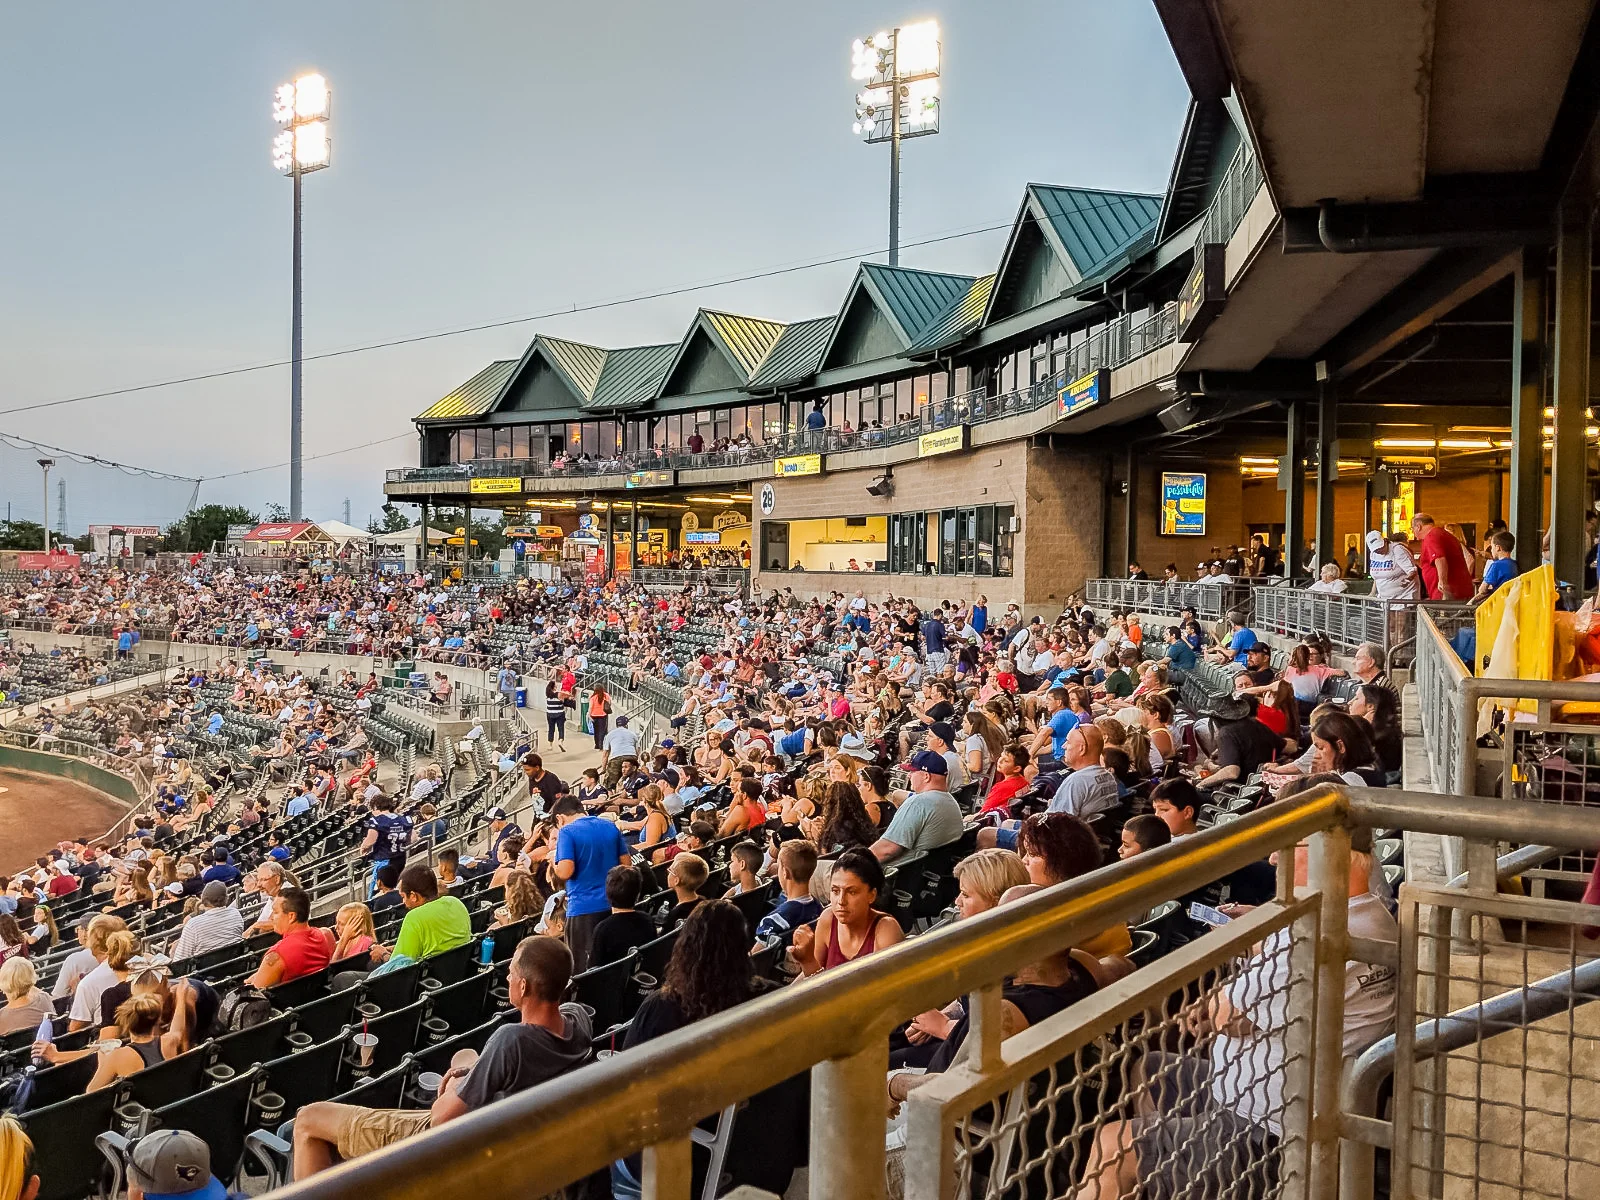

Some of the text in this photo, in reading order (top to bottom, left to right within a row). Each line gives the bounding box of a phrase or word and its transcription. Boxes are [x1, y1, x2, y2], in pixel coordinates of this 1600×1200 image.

[763, 490, 772, 508] 28
[718, 516, 741, 525] PIZZA
[126, 527, 157, 535] SPEED PITCH
[449, 816, 459, 828] 102
